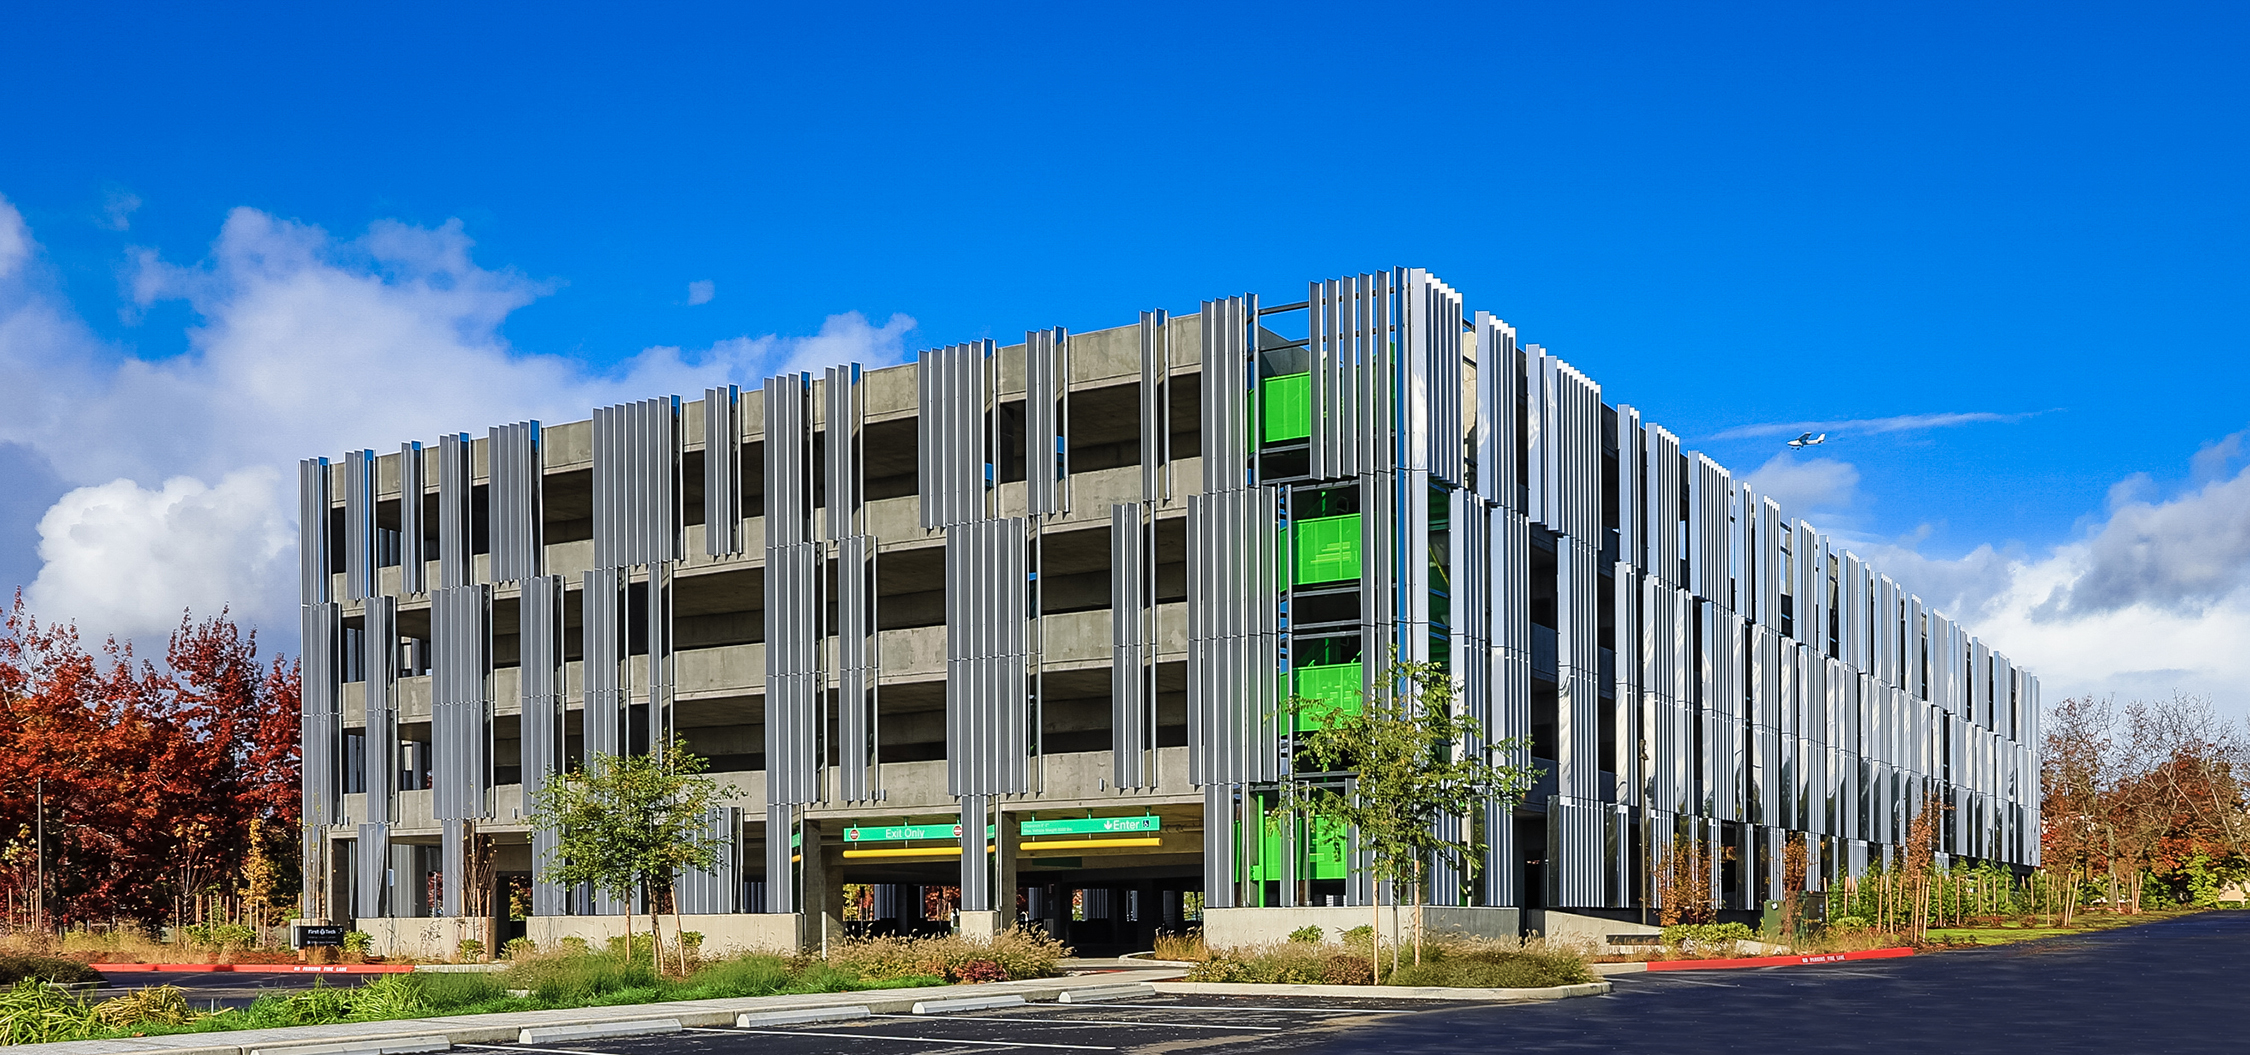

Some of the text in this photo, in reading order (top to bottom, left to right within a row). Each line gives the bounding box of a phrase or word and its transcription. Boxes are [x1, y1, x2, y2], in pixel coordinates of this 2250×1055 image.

[1113, 820, 1139, 830] Enter
[886, 828, 925, 839] Exit Only
